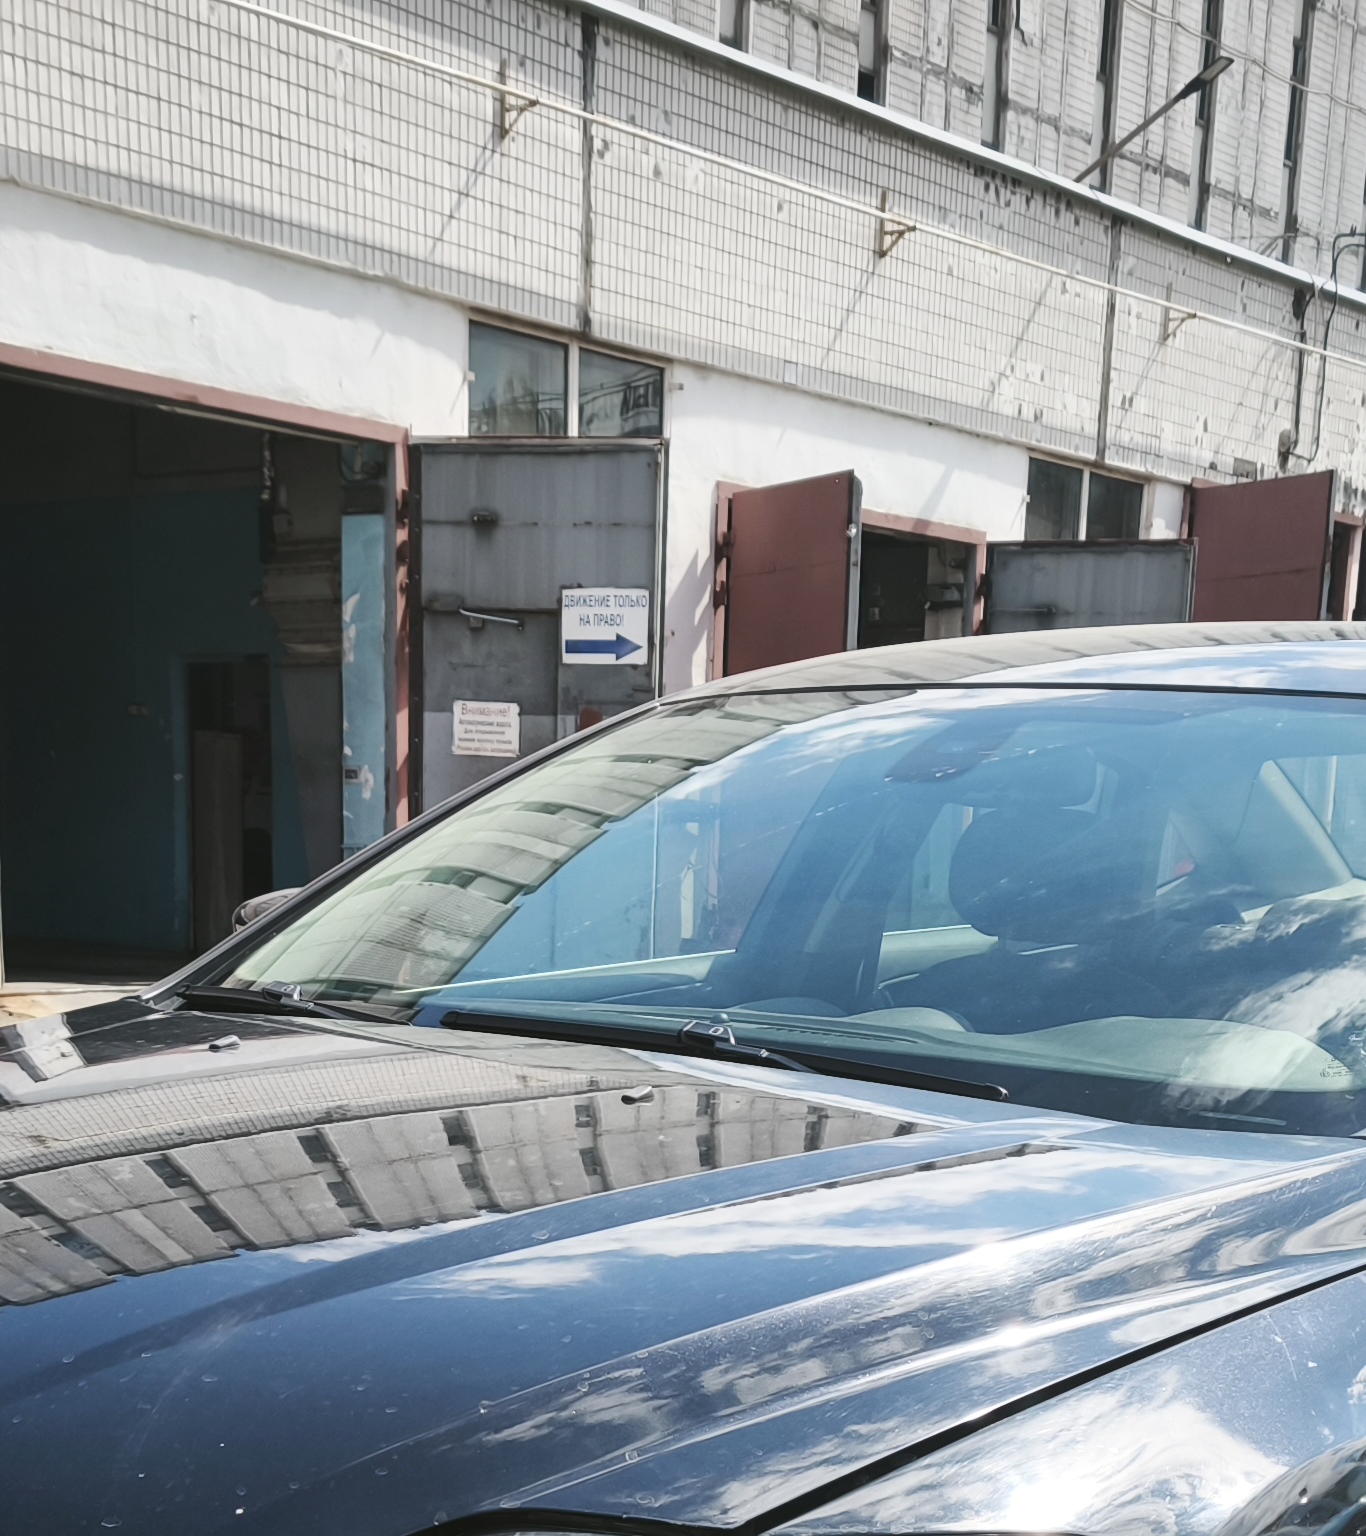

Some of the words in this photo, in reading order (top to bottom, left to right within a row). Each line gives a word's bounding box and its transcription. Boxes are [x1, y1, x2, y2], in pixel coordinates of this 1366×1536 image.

[564, 594, 611, 609] ДВИЖЕНИЕ
[613, 594, 648, 608] ТОЛЬКО
[579, 613, 591, 627] НА
[593, 613, 624, 627] ПРАВО!
[461, 703, 511, 717] Внимание!
